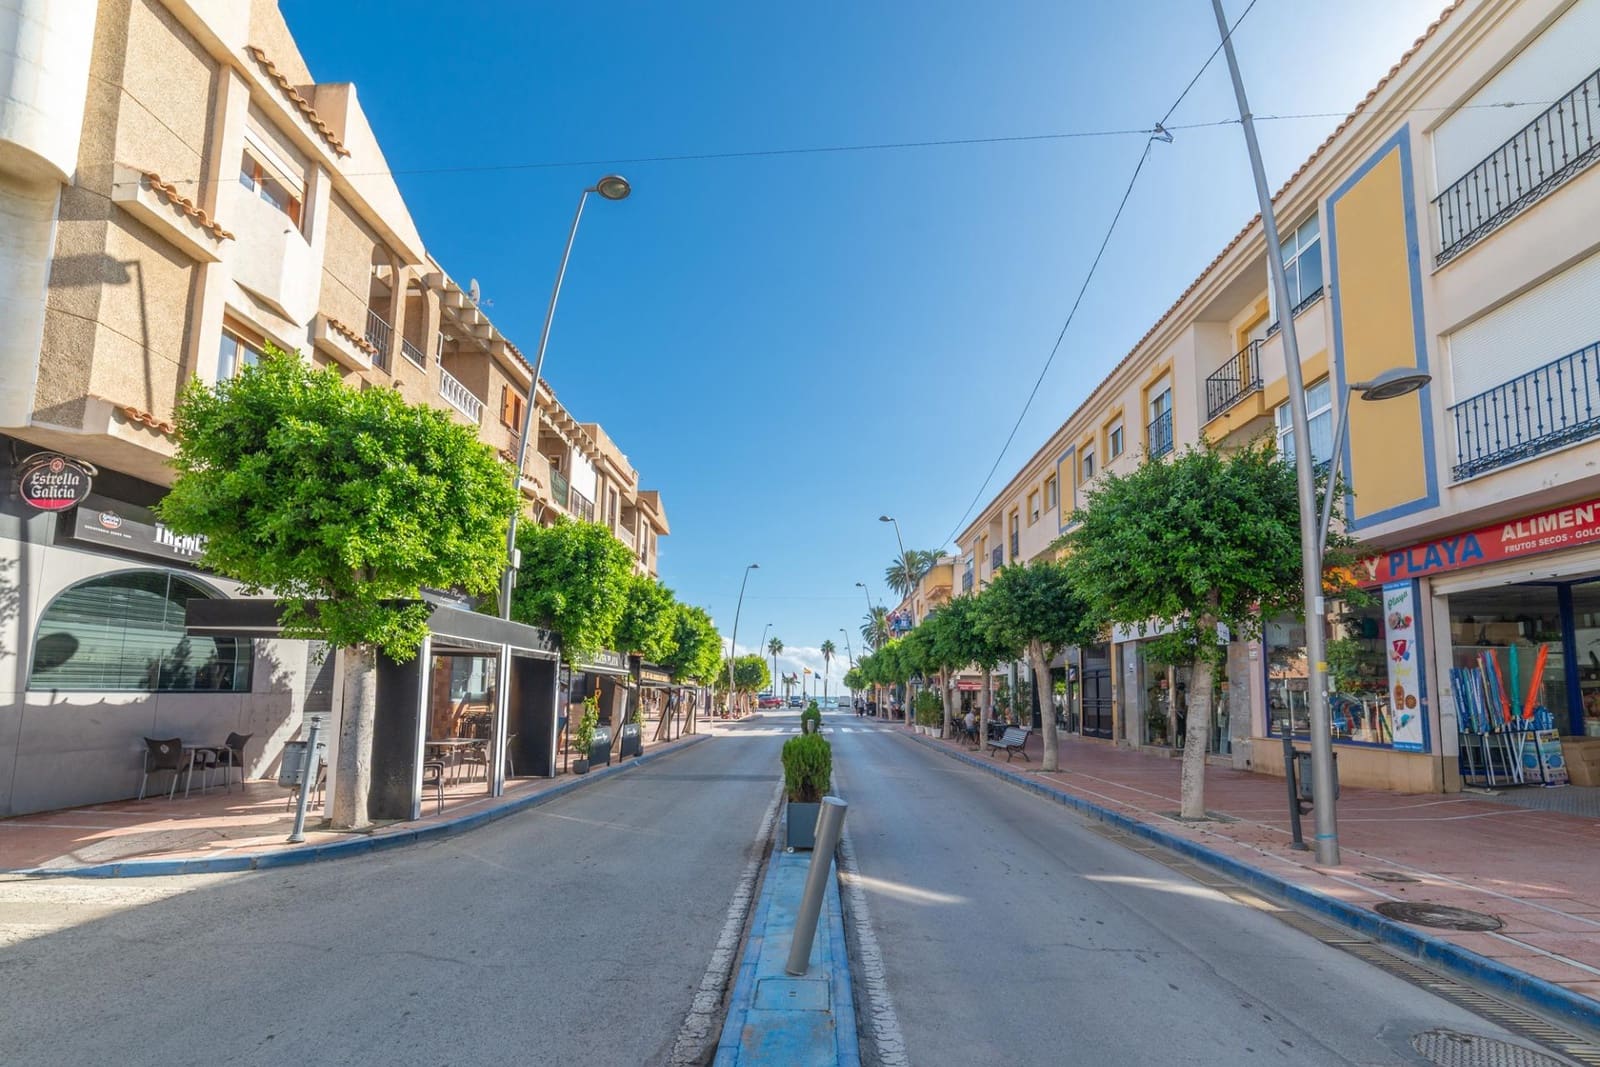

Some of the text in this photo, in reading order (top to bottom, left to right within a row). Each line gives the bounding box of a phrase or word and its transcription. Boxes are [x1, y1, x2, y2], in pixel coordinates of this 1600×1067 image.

[31, 472, 80, 485] Estrella
[31, 485, 75, 498] Galicia
[1501, 503, 1600, 542] ALIMEN
[1505, 540, 1537, 553] FRUTOS
[1539, 534, 1568, 546] SECOS
[1389, 533, 1484, 577] PLAYA
